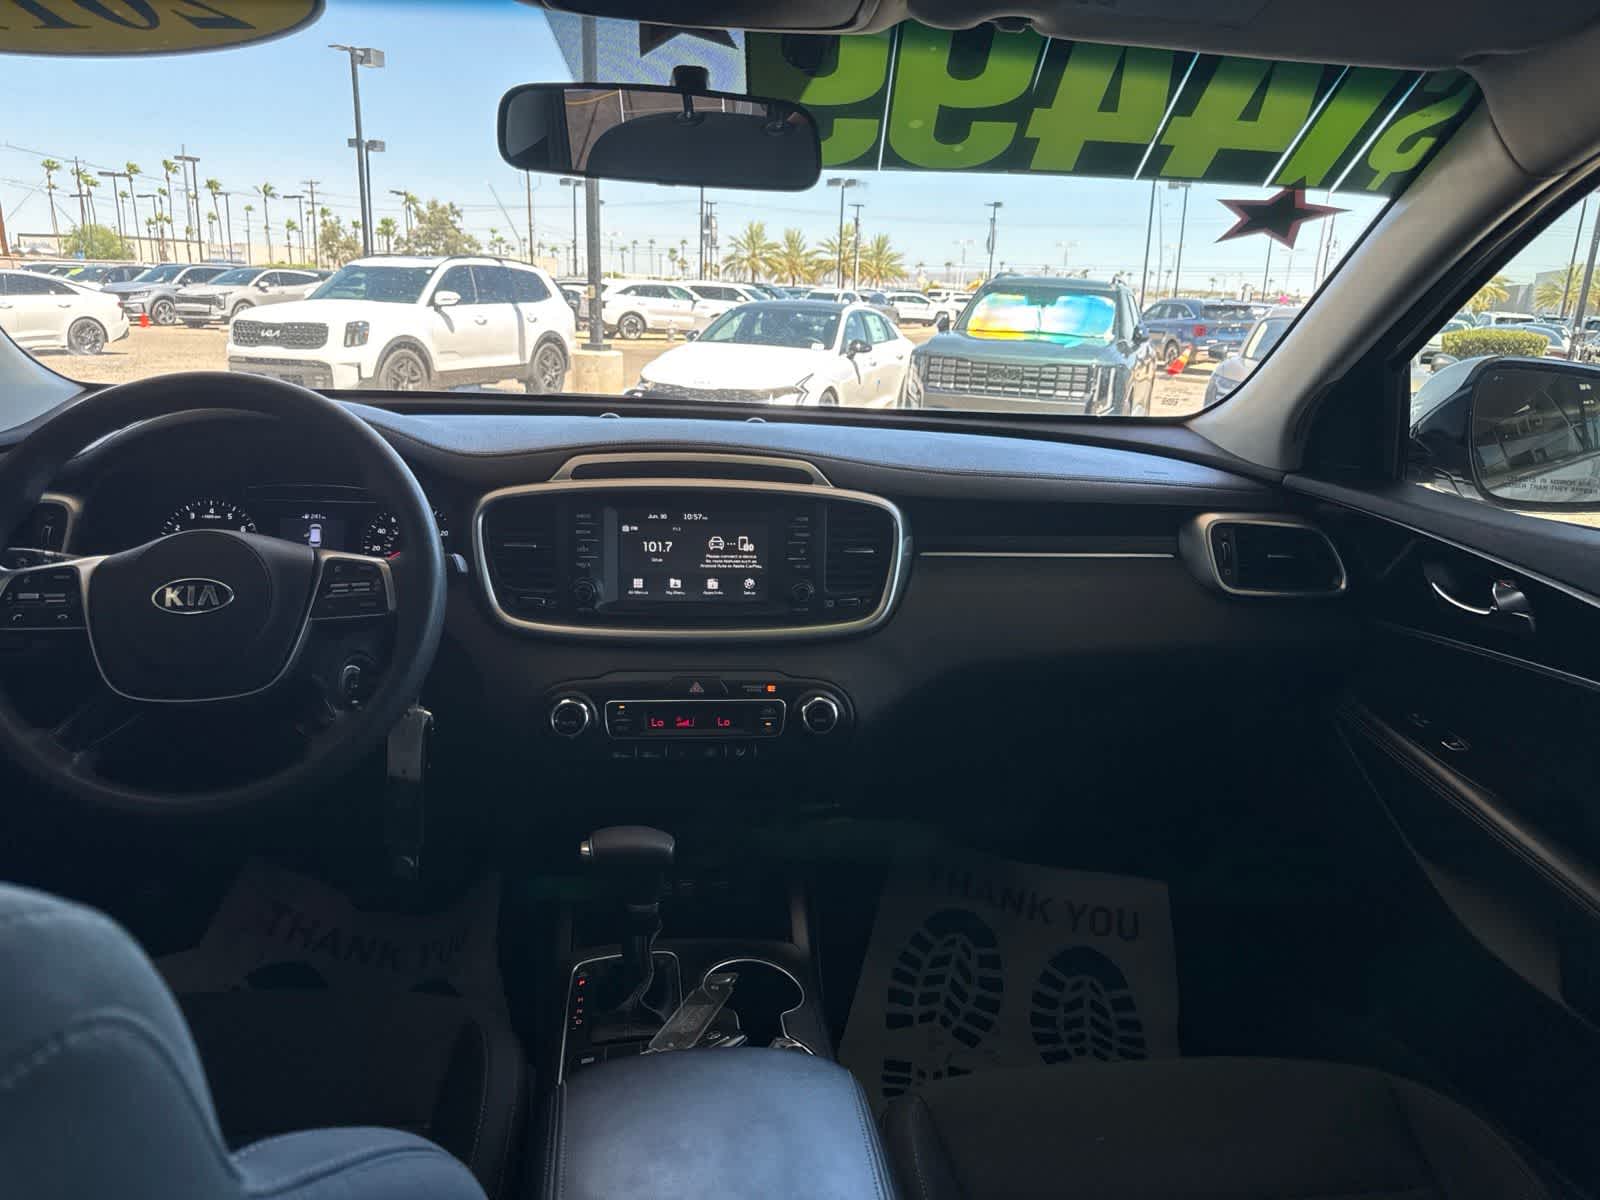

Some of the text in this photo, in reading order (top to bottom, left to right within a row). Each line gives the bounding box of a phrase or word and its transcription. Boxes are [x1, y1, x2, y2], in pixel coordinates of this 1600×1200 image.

[642, 541, 673, 553] 101.7
[163, 586, 220, 608] KIA
[1063, 898, 1142, 942] YOU
